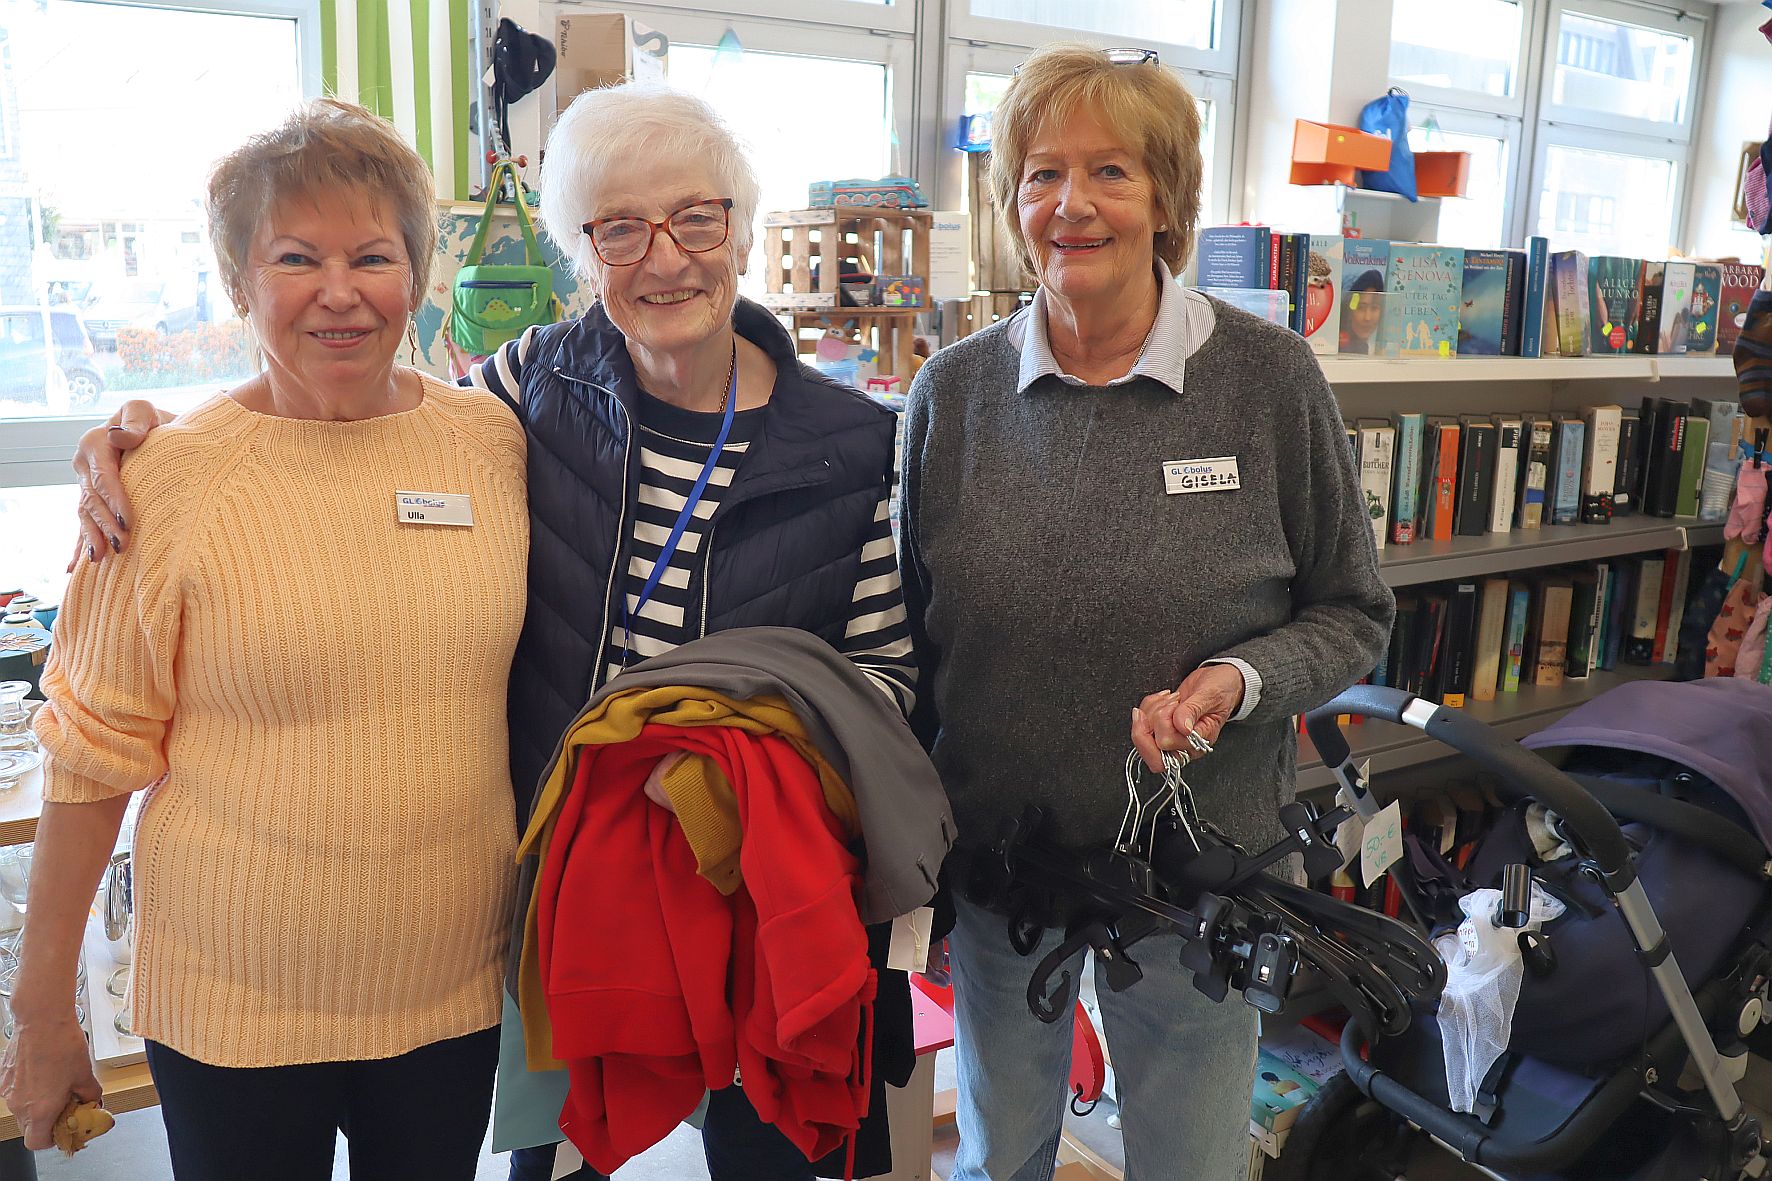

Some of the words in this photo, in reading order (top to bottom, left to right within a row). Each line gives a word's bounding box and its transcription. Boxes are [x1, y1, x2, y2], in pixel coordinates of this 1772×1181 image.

[1412, 256, 1438, 268] LISA
[1722, 265, 1760, 275] ARBARA
[1397, 269, 1452, 282] GENOVA
[1603, 278, 1636, 288] ALICE
[1599, 288, 1639, 299] MUNRO
[1404, 306, 1439, 316] LEBEN
[1362, 460, 1390, 470] BUTCHER
[1181, 472, 1237, 489] GISELA
[407, 511, 425, 520] Ulla
[1373, 850, 1388, 869] VB
